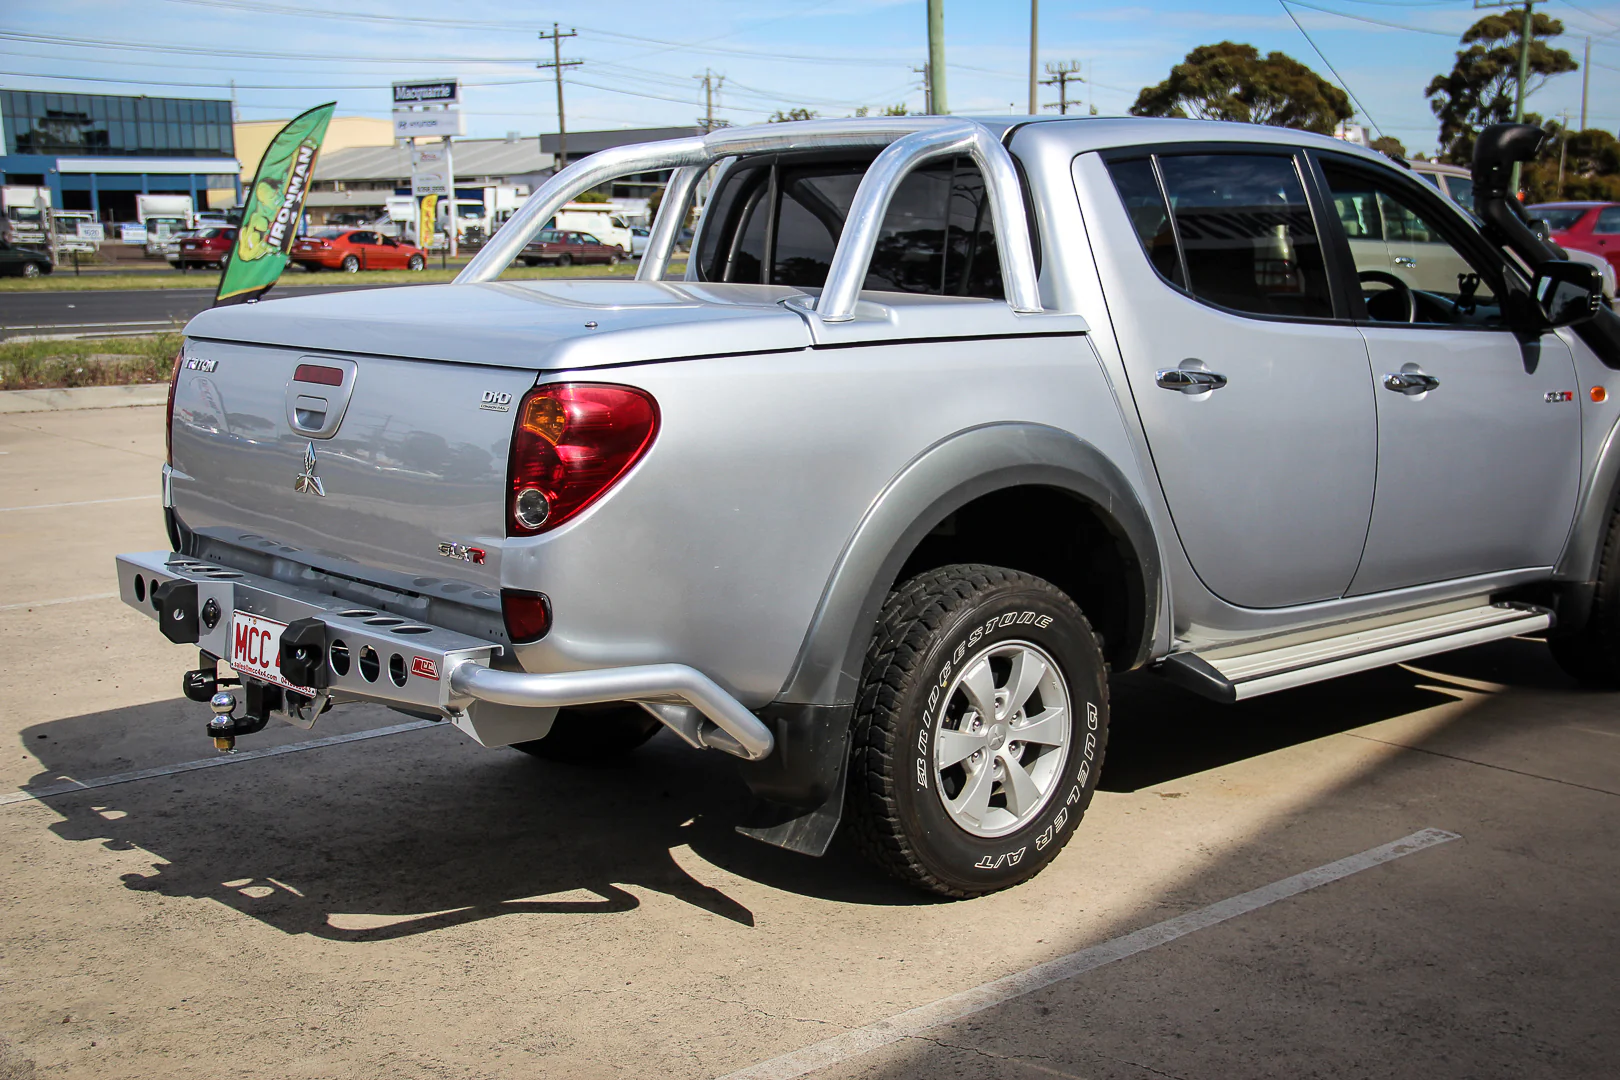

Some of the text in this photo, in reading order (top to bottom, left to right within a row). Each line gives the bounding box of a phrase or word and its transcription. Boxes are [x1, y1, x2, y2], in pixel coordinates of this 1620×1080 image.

[268, 146, 313, 247] IRONMAN
[234, 622, 271, 669] MCC
[917, 611, 1053, 788] BRIDGESTONE
[975, 702, 1097, 869] DUELER A/T
